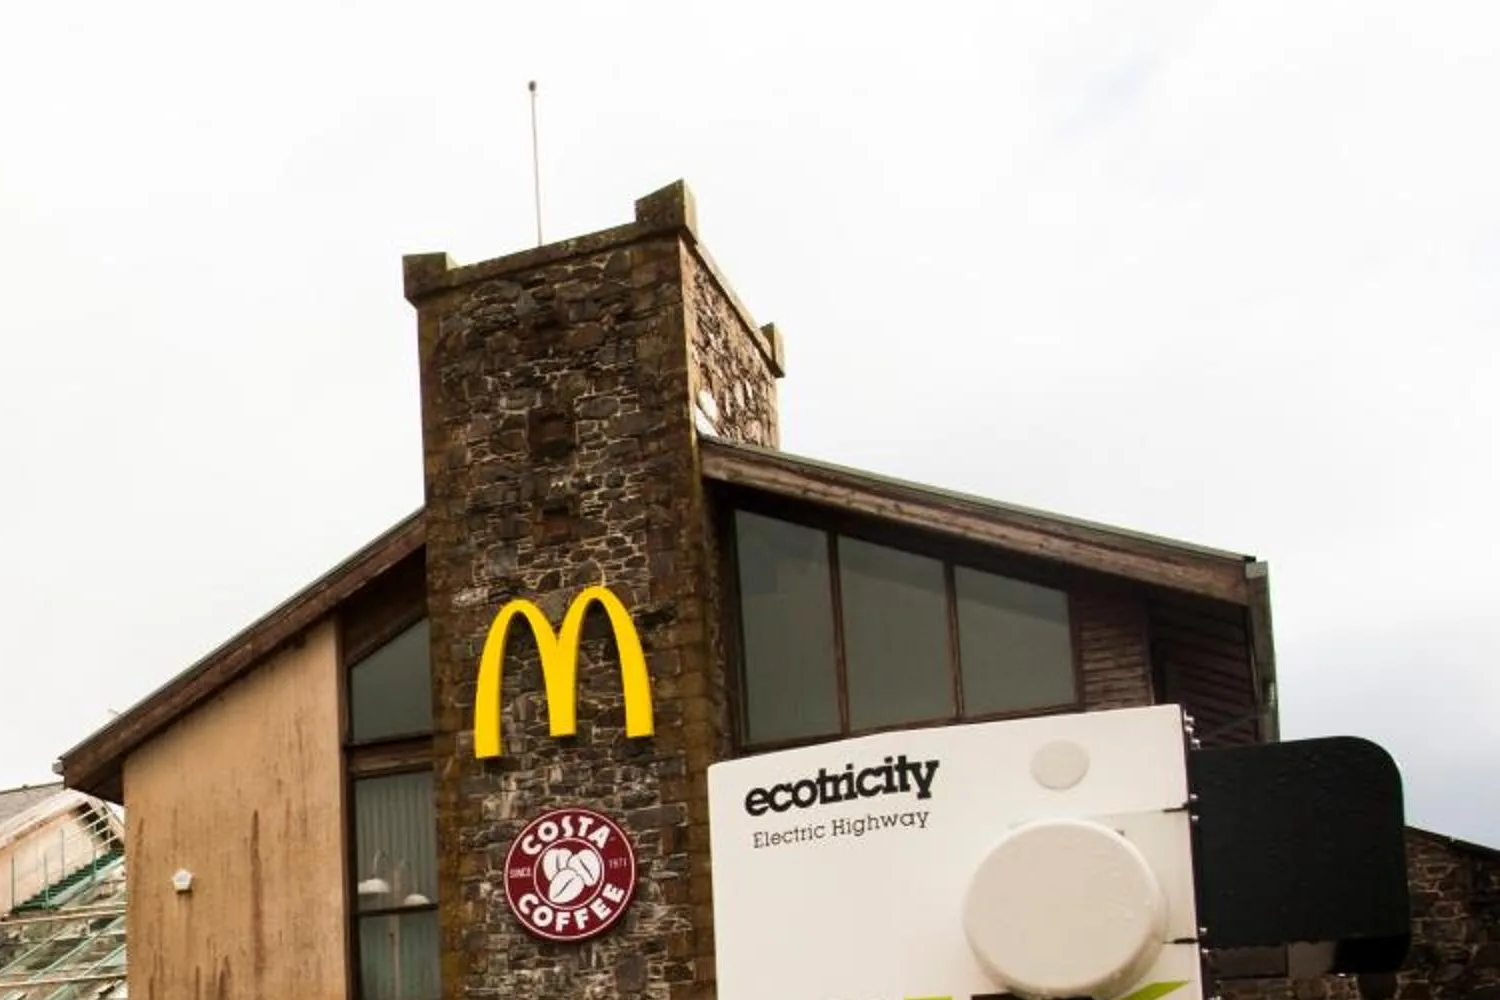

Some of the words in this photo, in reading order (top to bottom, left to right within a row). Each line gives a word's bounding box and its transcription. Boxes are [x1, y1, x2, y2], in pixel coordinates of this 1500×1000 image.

[744, 755, 940, 817] ecotricity
[521, 815, 611, 855] COSTA
[752, 823, 826, 849] Electric
[831, 811, 930, 837] Highway
[510, 867, 532, 879] SINCE
[518, 883, 625, 932] COFFEE
